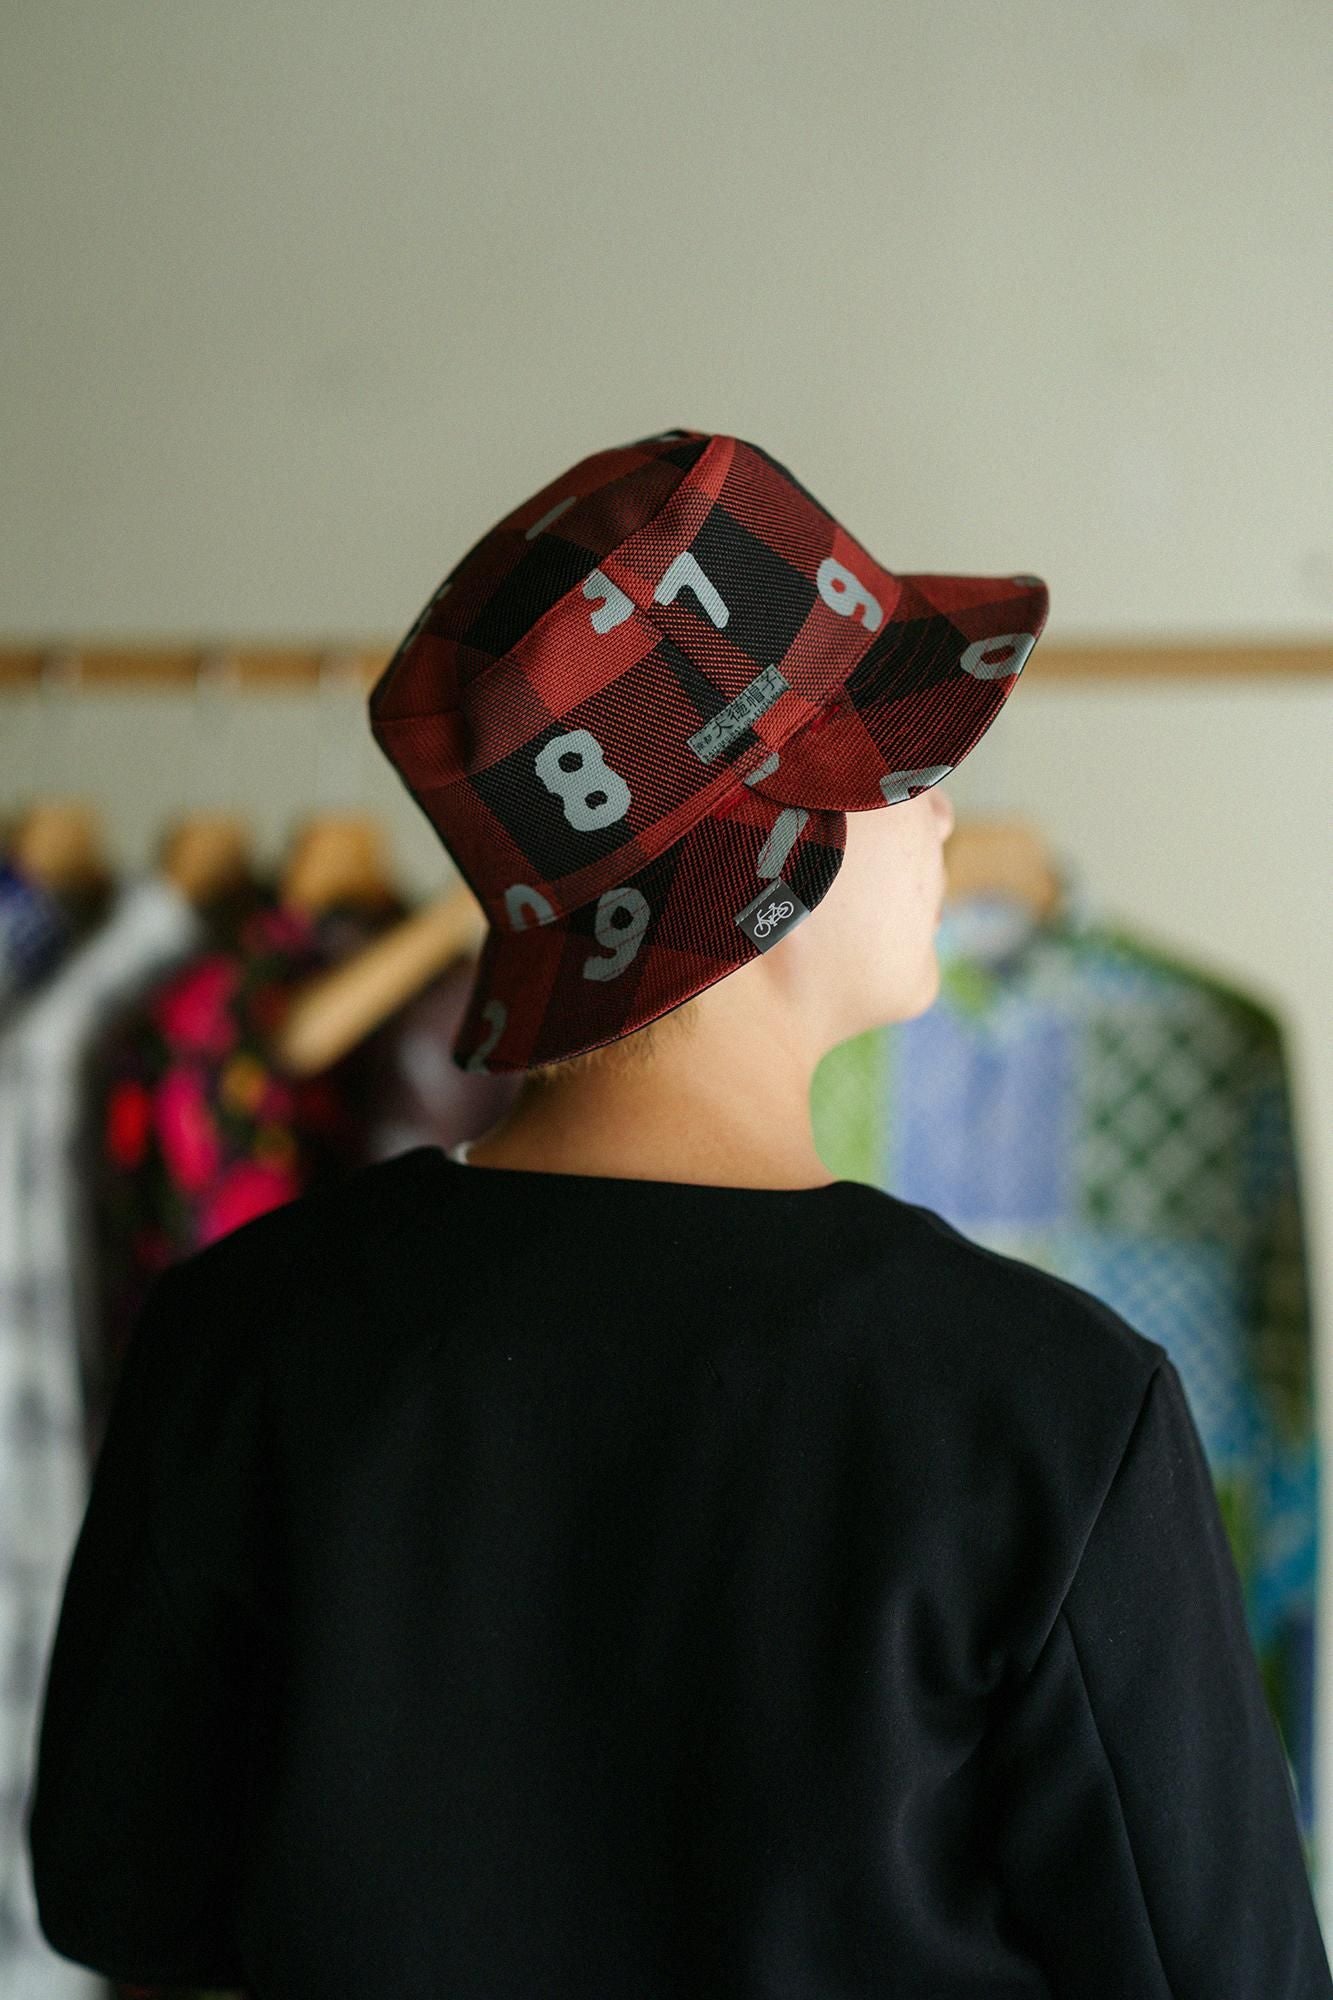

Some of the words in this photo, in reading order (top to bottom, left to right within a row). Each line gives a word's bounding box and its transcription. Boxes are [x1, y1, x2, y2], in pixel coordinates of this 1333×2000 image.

[653, 551, 730, 629] 7
[816, 558, 884, 632] 9
[535, 729, 632, 832] 8
[583, 887, 650, 982] 9
